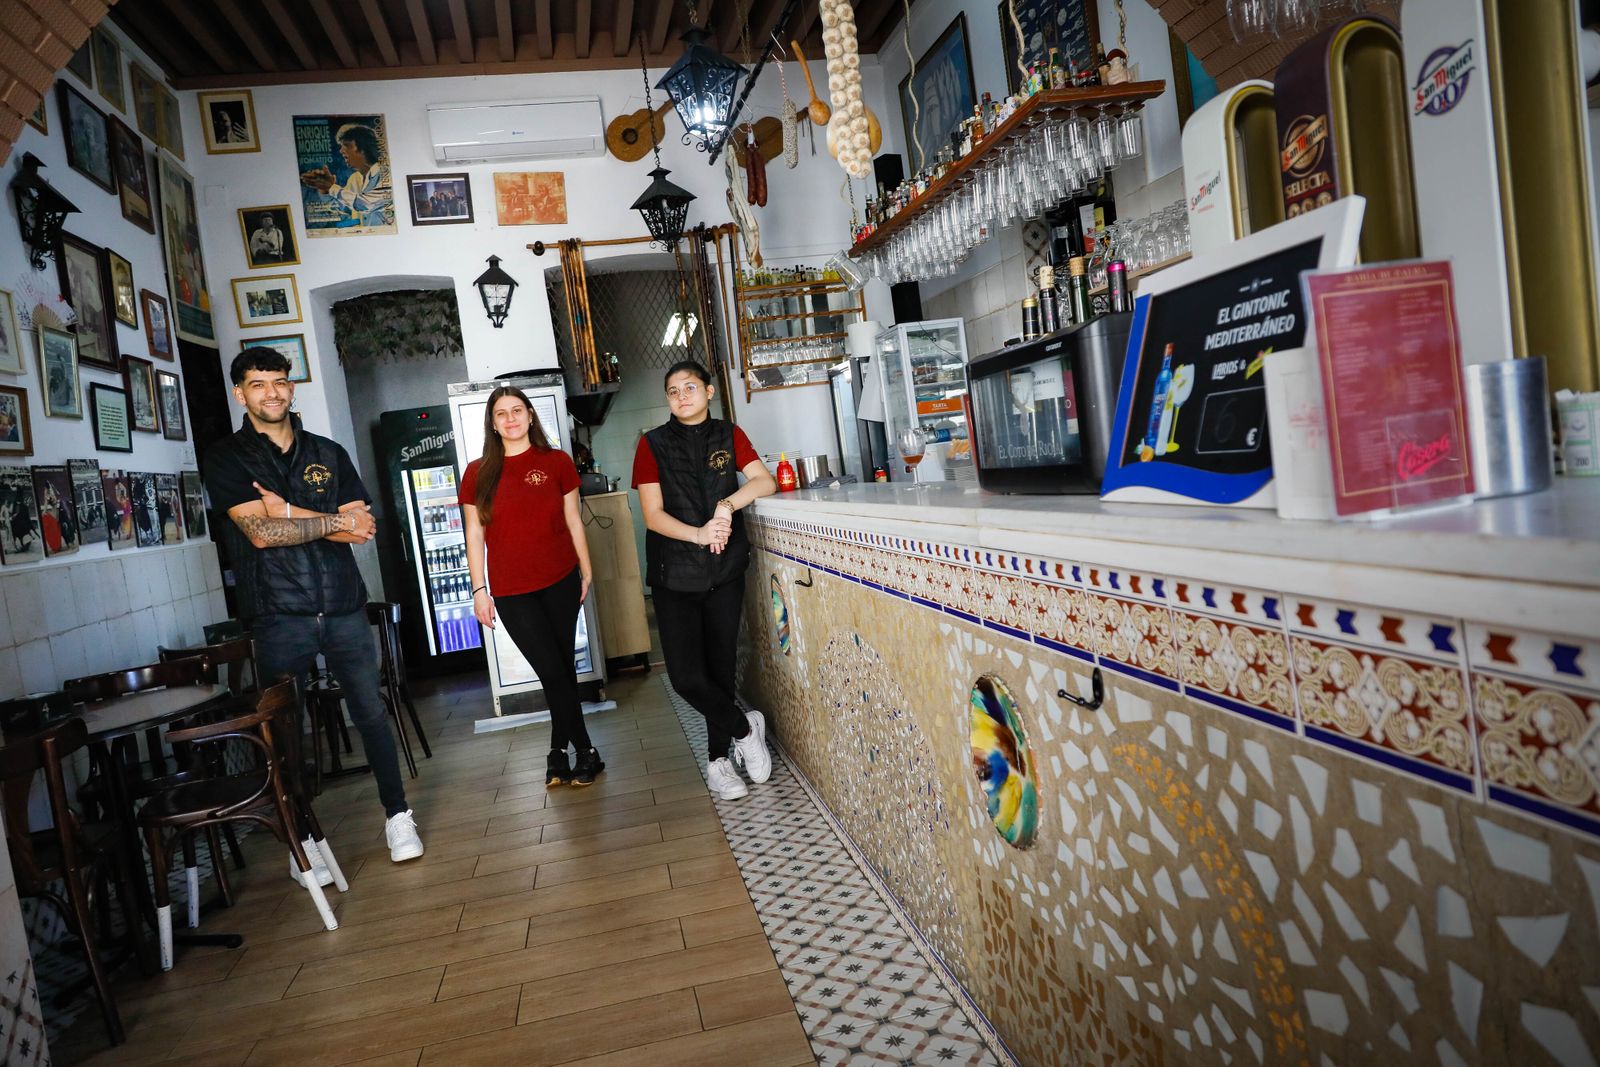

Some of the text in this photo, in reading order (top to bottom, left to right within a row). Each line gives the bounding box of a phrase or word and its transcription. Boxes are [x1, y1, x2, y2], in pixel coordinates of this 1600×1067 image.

[296, 126, 330, 139] ENRIQUE
[298, 139, 332, 152] MORENTE
[1285, 171, 1331, 198] SELECTA
[1217, 289, 1290, 325] EL GINTONIC
[1204, 314, 1295, 351] MEDITERRÁNEO
[1211, 359, 1239, 380] LARIOS
[1246, 428, 1258, 446] €
